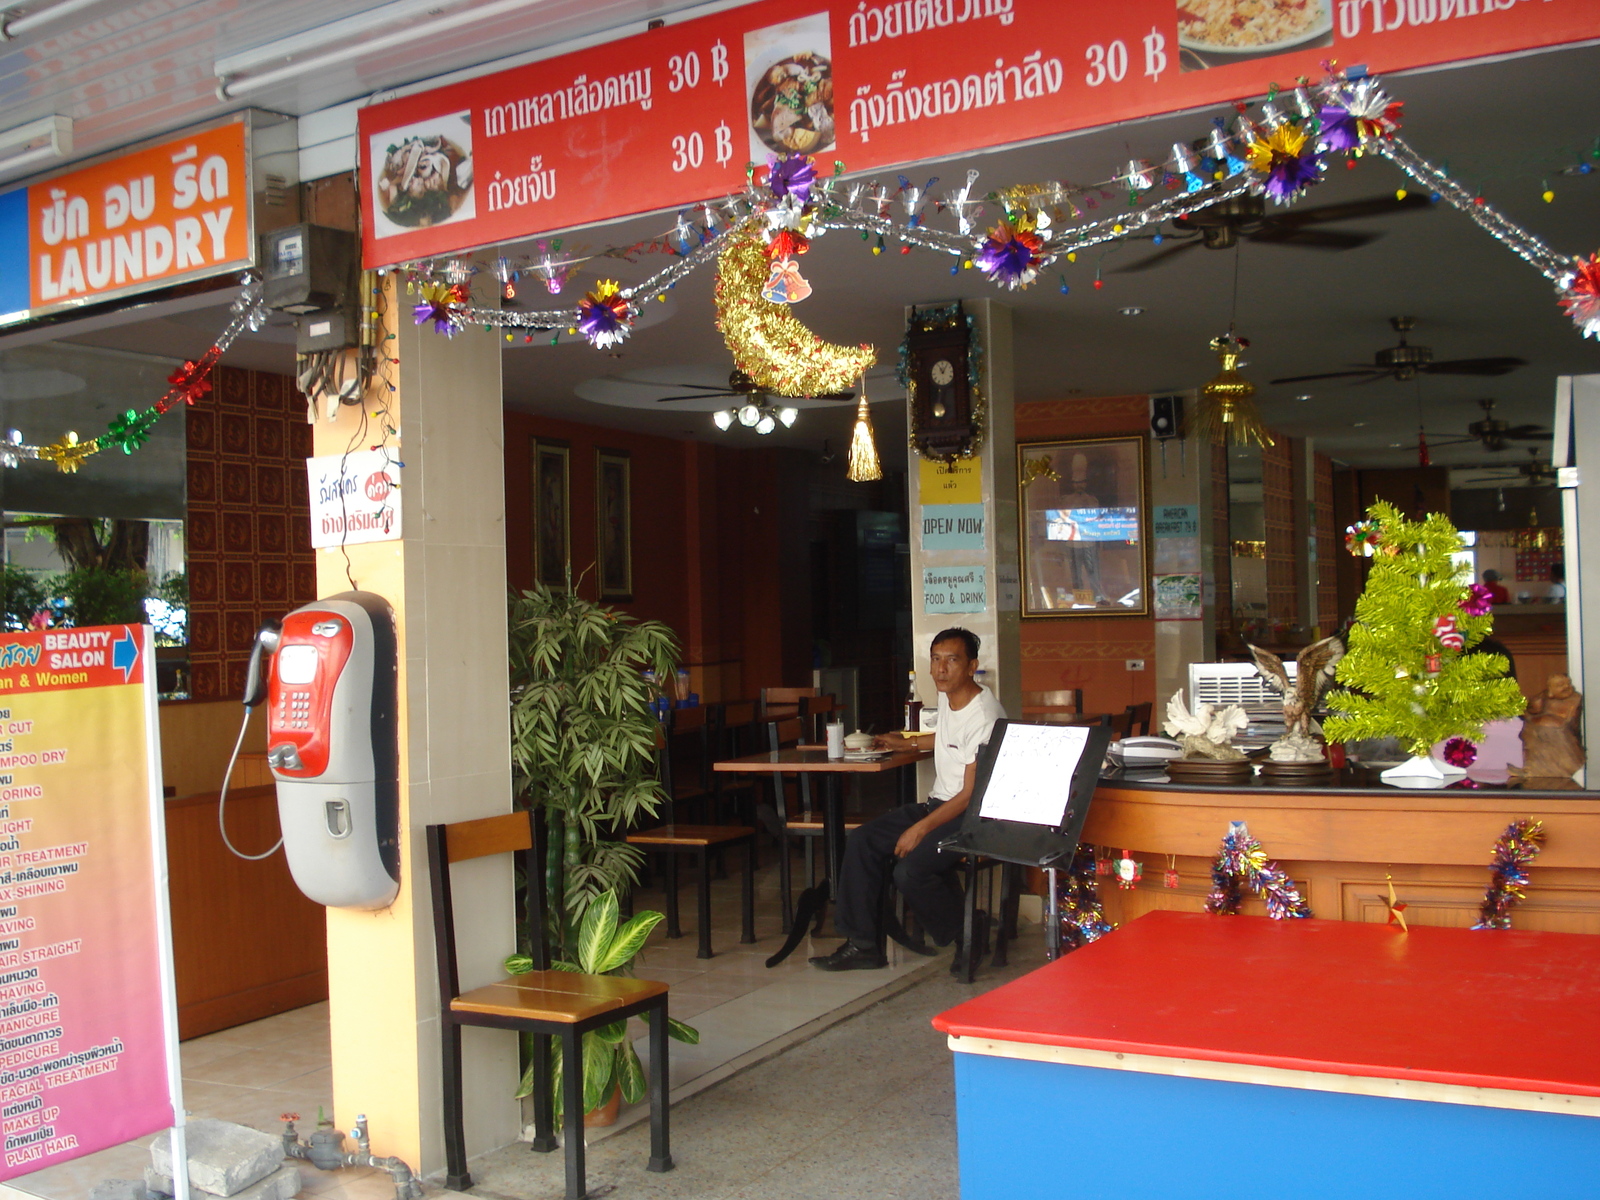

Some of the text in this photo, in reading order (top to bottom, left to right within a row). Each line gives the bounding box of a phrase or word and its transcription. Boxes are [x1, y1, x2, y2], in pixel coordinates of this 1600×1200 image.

[484, 66, 653, 138] เกาเหลาเลือดหมู
[667, 51, 700, 93] 30
[849, 50, 1063, 143] กุ๊งกิ๊งยอดตำลึง
[1084, 40, 1128, 87] 30
[487, 154, 556, 212] ก๋วยจั๊บ
[671, 132, 704, 172] 30
[104, 174, 156, 230] อบ
[172, 144, 229, 210] รีด
[40, 206, 233, 301] LAUNDRY
[923, 518, 982, 535] OPEN NOW
[978, 574, 984, 583] 3
[925, 592, 984, 605] FOOD & DRINK
[45, 631, 111, 651] BEAUTY
[51, 651, 105, 670] SALON
[19, 673, 31, 688] &
[36, 672, 88, 686] Women
[8, 721, 32, 734] CUT
[42, 750, 66, 763] DRY
[0, 786, 42, 801] ORING
[16, 843, 87, 865] TREATMENT
[23, 941, 80, 963] STRAIGHT
[0, 1042, 58, 1069] PEDICURE
[1, 1059, 117, 1101] FACIAL TREATMENT
[4, 1107, 58, 1133] MAKE UP
[7, 1136, 77, 1166] PLAIT HAIR
